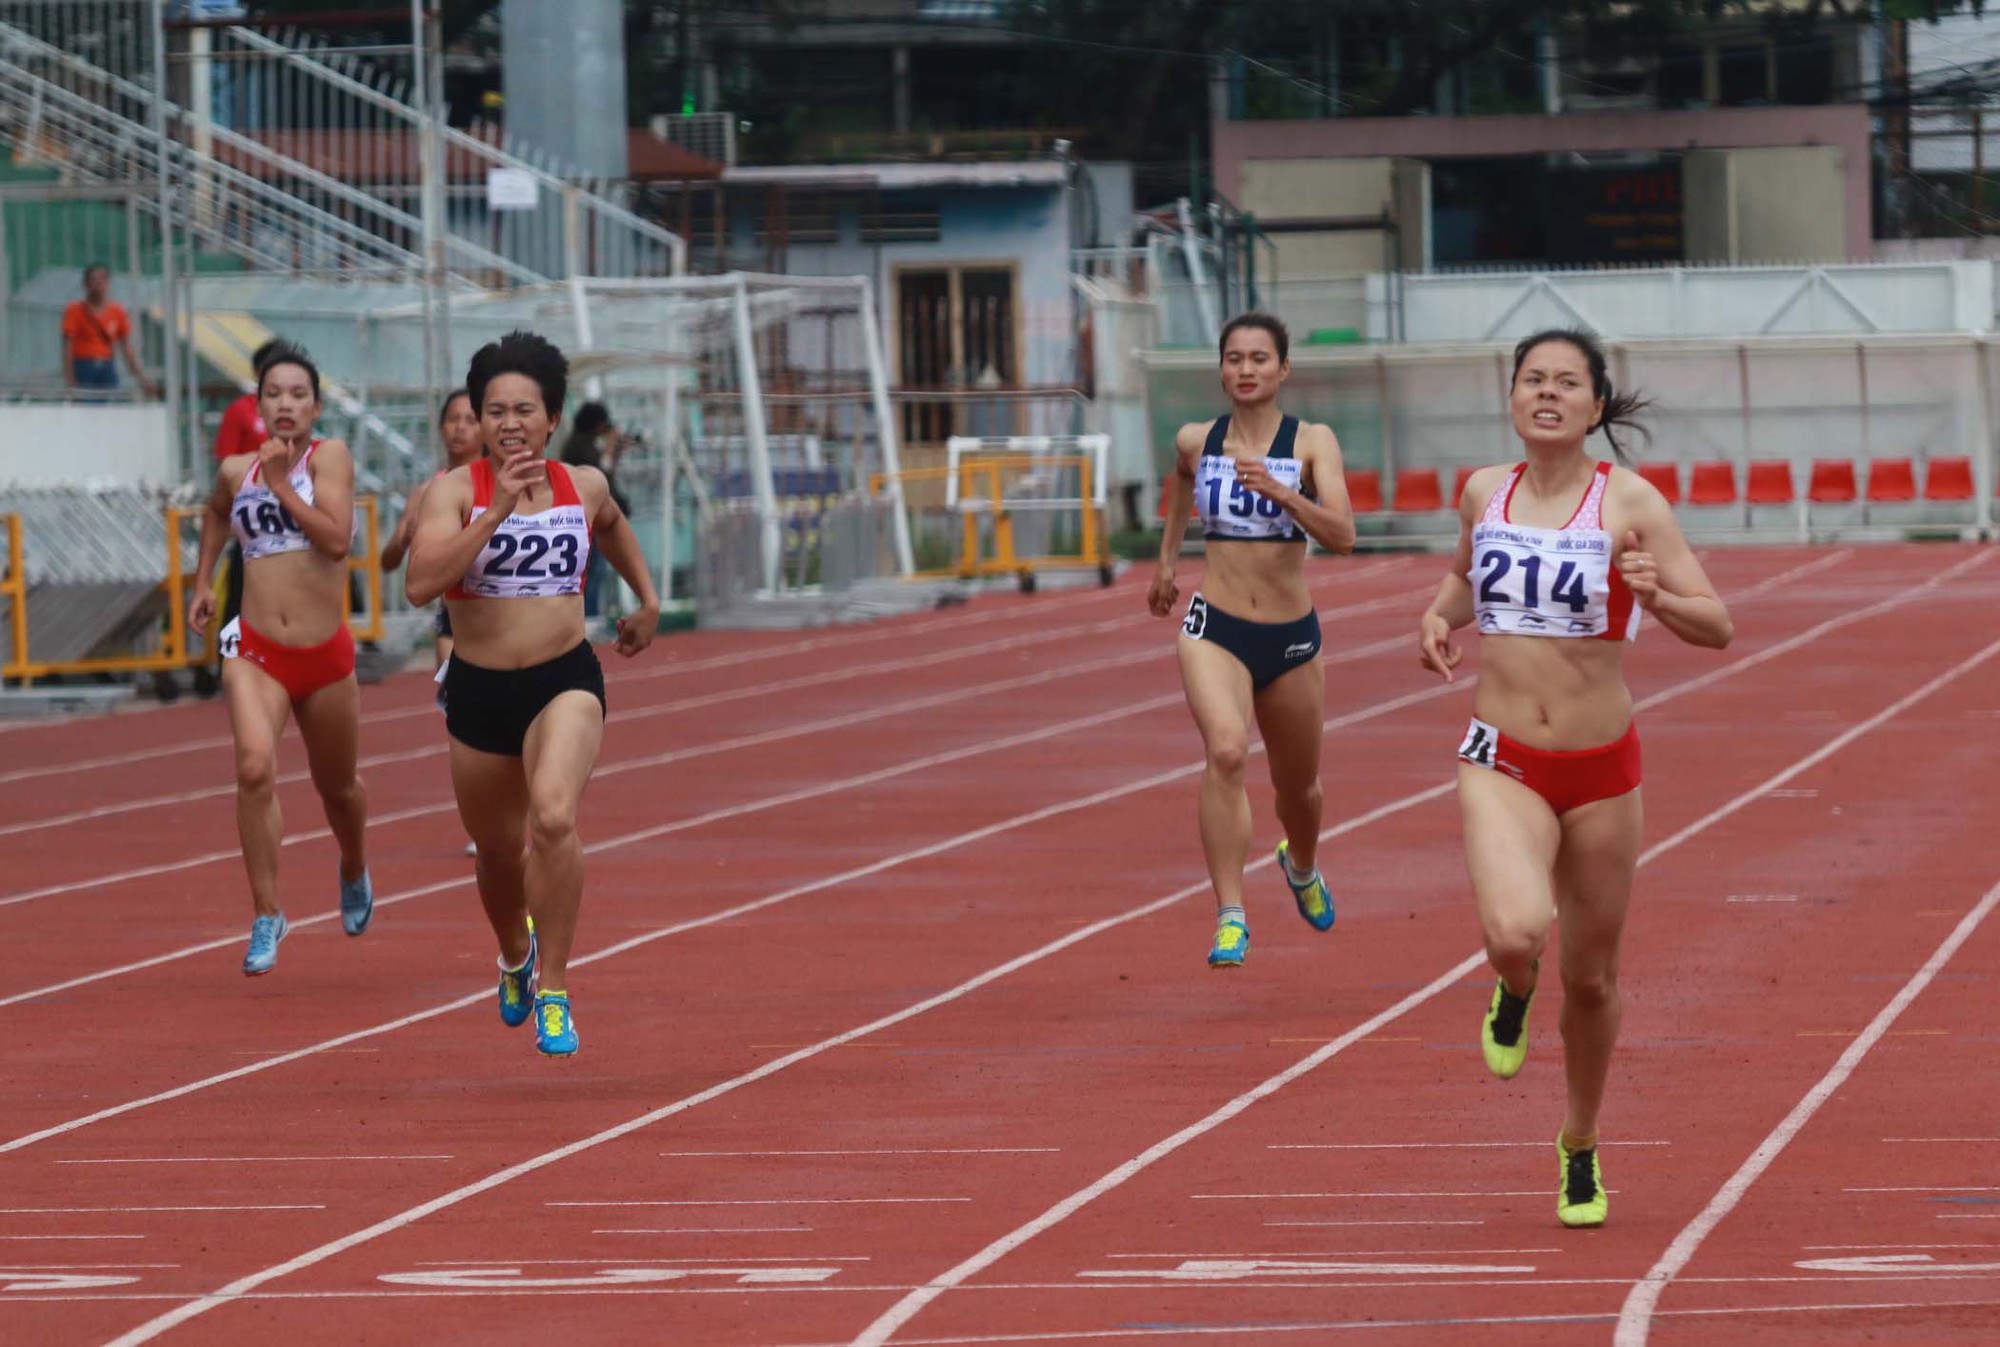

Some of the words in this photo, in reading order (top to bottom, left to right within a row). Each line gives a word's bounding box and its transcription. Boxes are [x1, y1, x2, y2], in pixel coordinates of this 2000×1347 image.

[483, 533, 578, 578] 223
[1480, 549, 1589, 613] 214
[1183, 596, 1206, 635] 5
